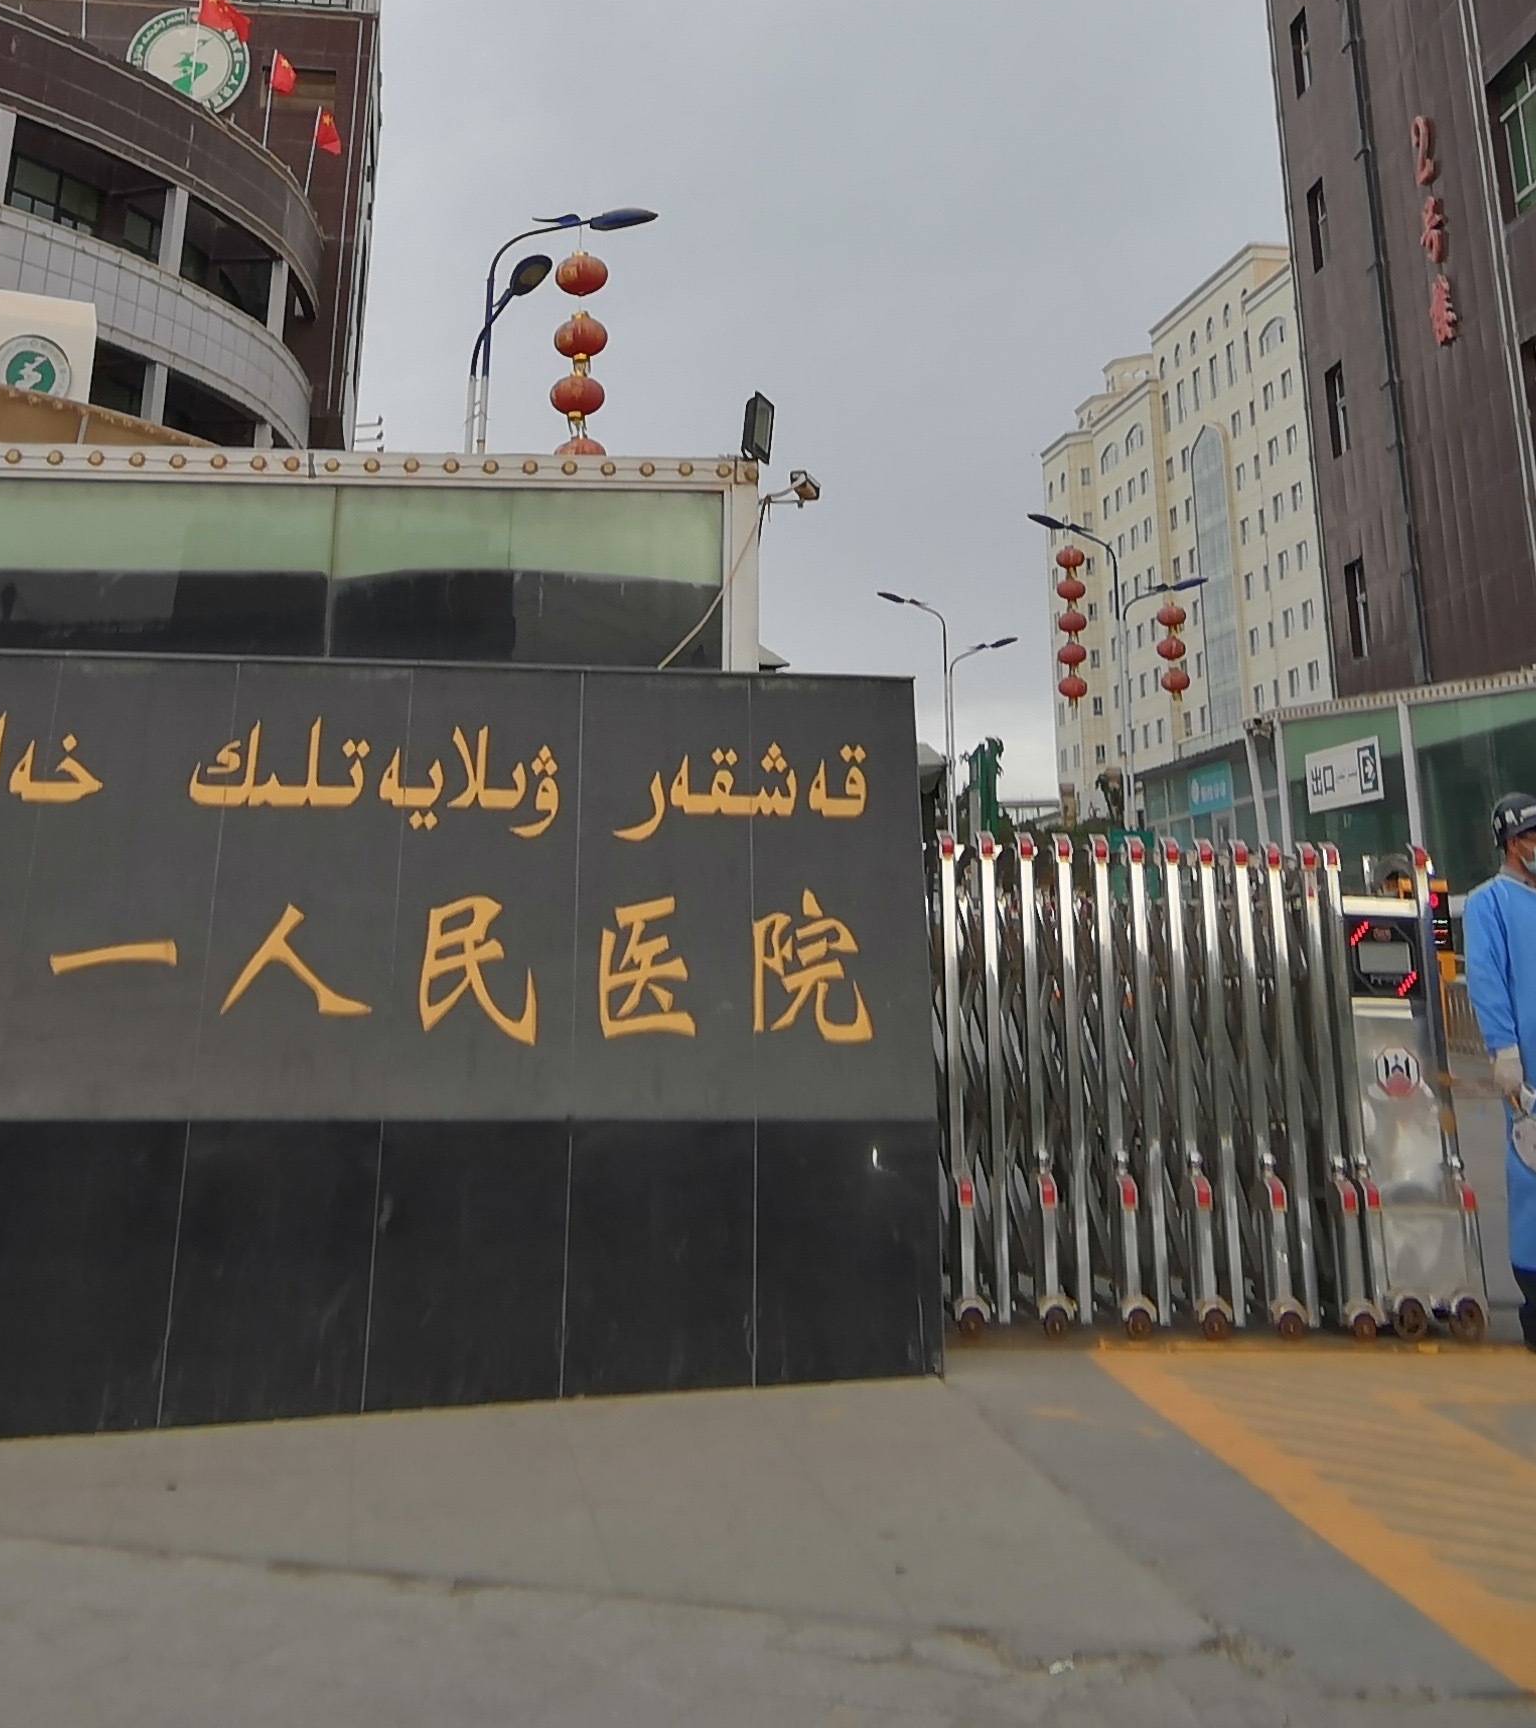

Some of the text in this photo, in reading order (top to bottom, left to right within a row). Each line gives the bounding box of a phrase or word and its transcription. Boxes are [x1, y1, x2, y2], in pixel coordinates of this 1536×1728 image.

[188, 715, 560, 839] ۋىلايەتلىك
[612, 739, 867, 842] قەشقەر
[1311, 765, 1336, 796] 出口
